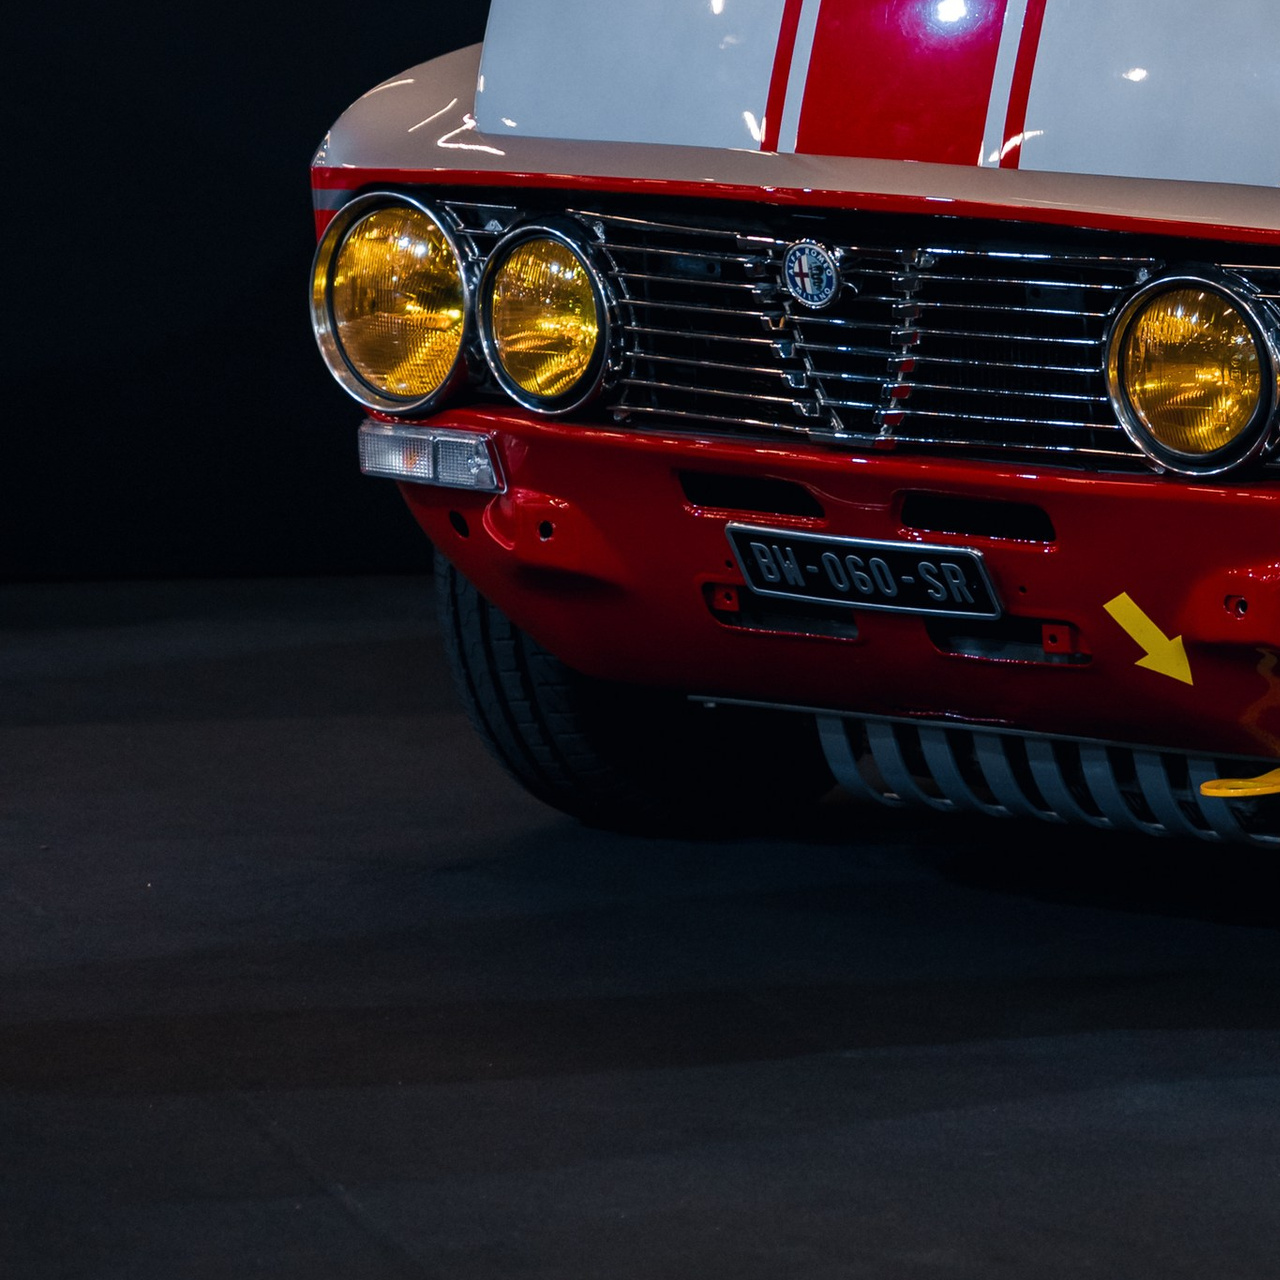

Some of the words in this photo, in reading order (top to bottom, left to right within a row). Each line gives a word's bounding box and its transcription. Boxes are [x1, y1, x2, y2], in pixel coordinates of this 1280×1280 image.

[788, 250, 802, 276] ALFA
[804, 247, 833, 277] ROMEO
[795, 286, 831, 302] MILANO
